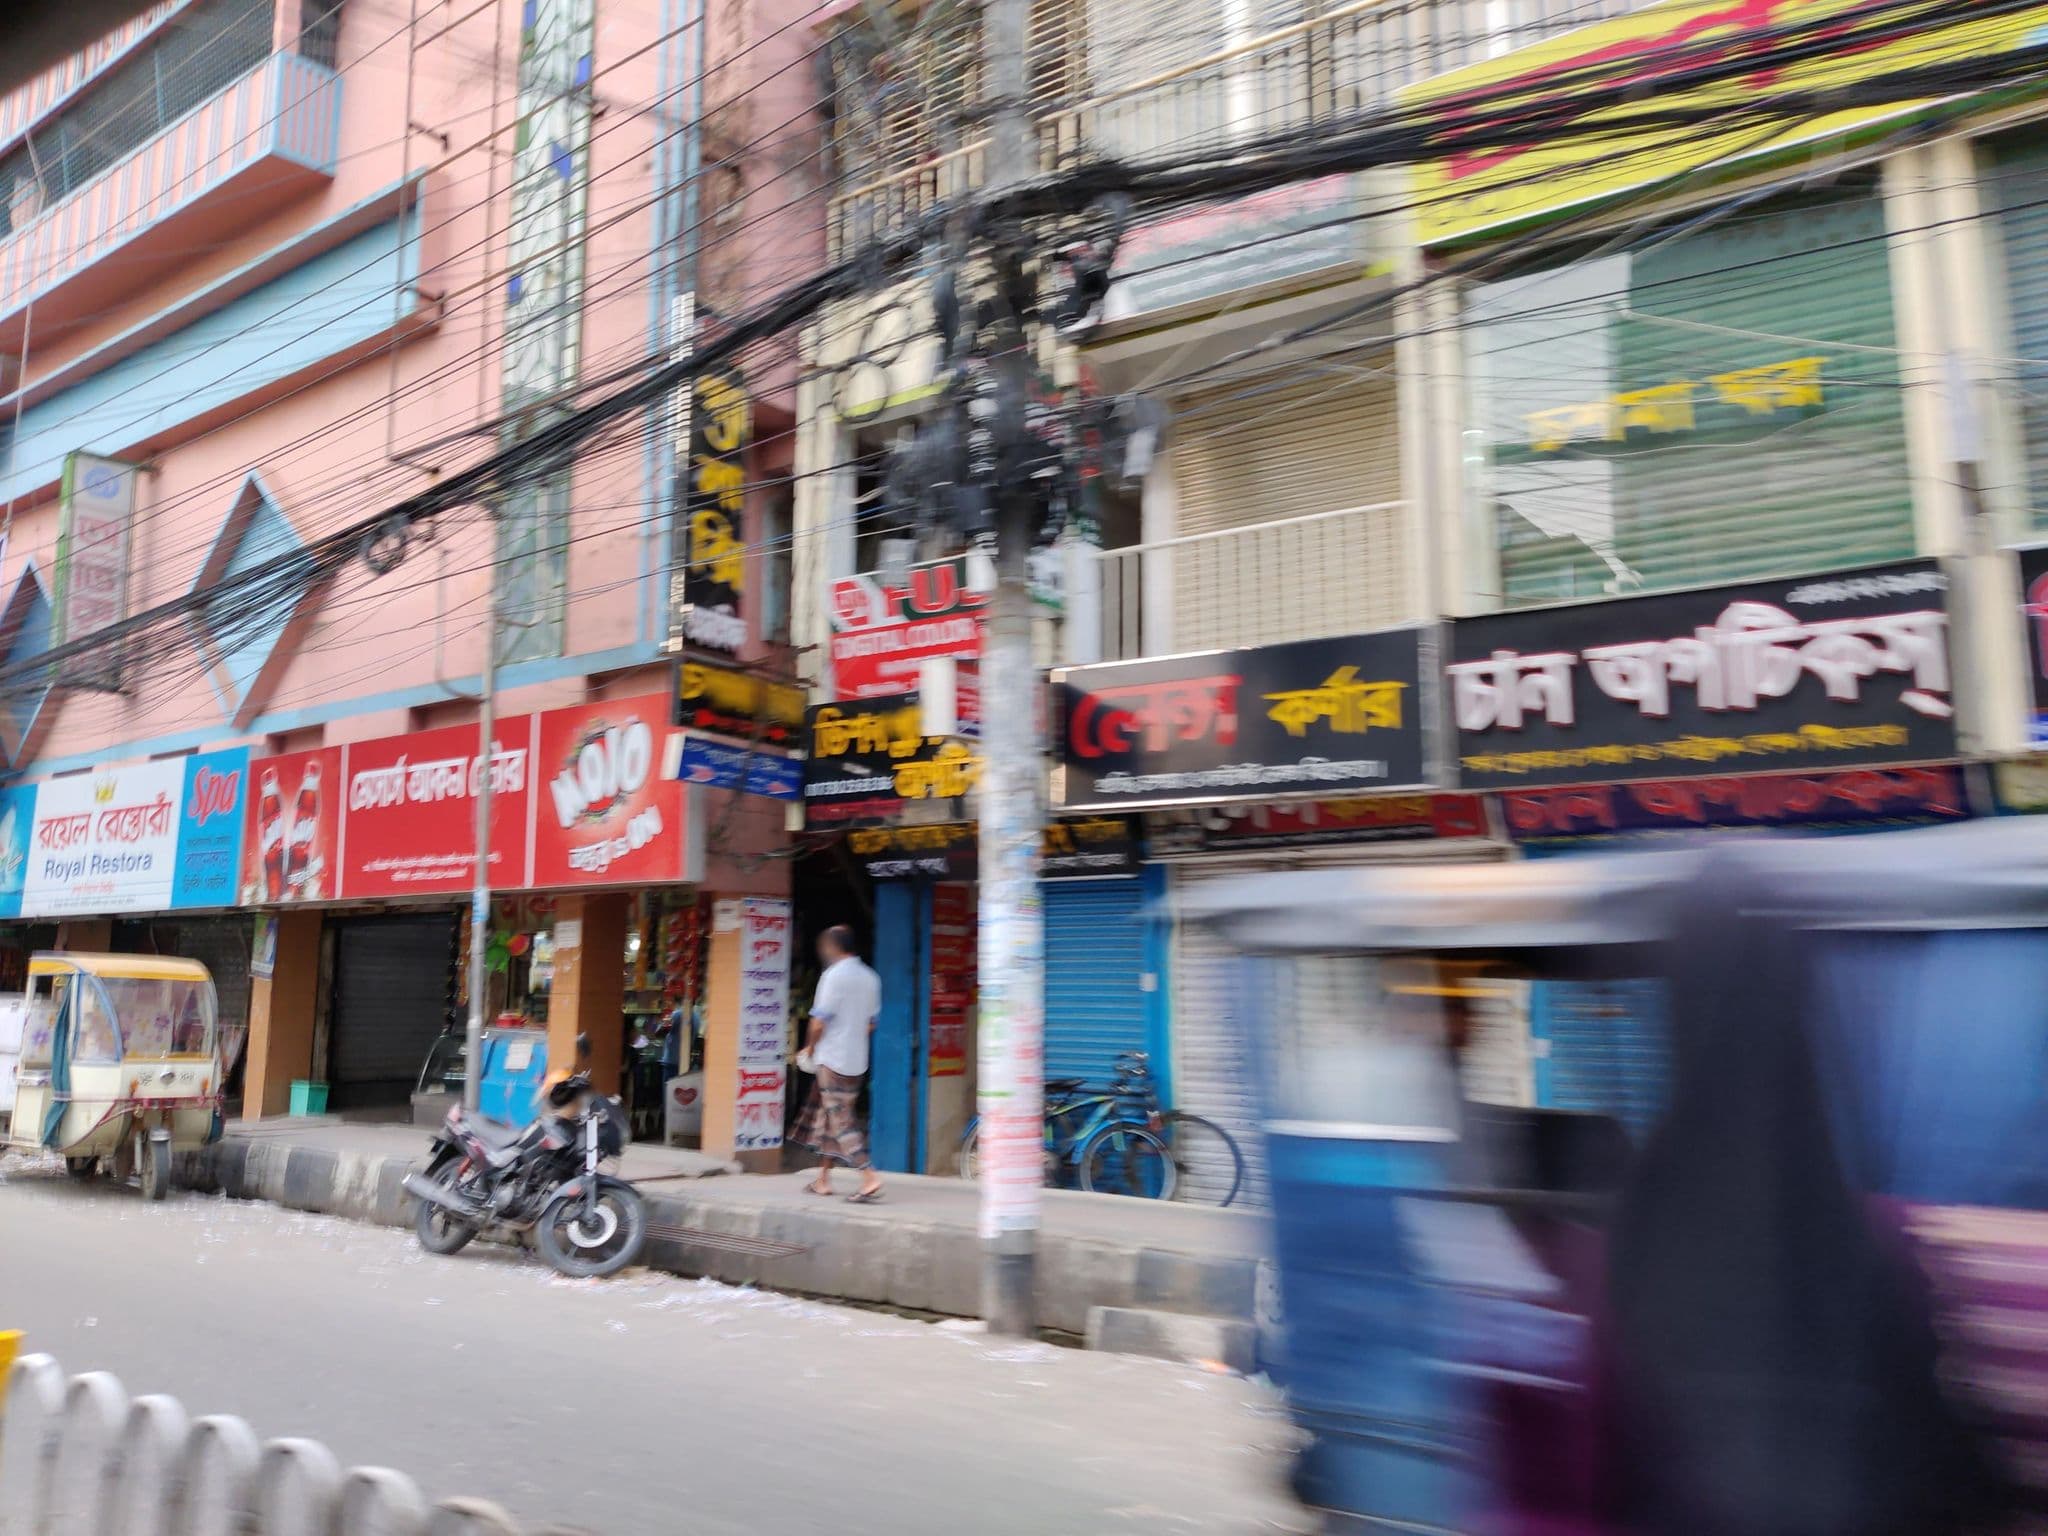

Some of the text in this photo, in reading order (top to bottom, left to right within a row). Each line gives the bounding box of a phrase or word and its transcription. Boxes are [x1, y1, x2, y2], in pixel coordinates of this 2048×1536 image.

[39, 791, 173, 851] রয়েল রেস্তোরাঁ
[188, 766, 241, 826] Spa
[44, 852, 152, 882] Royal Restora
